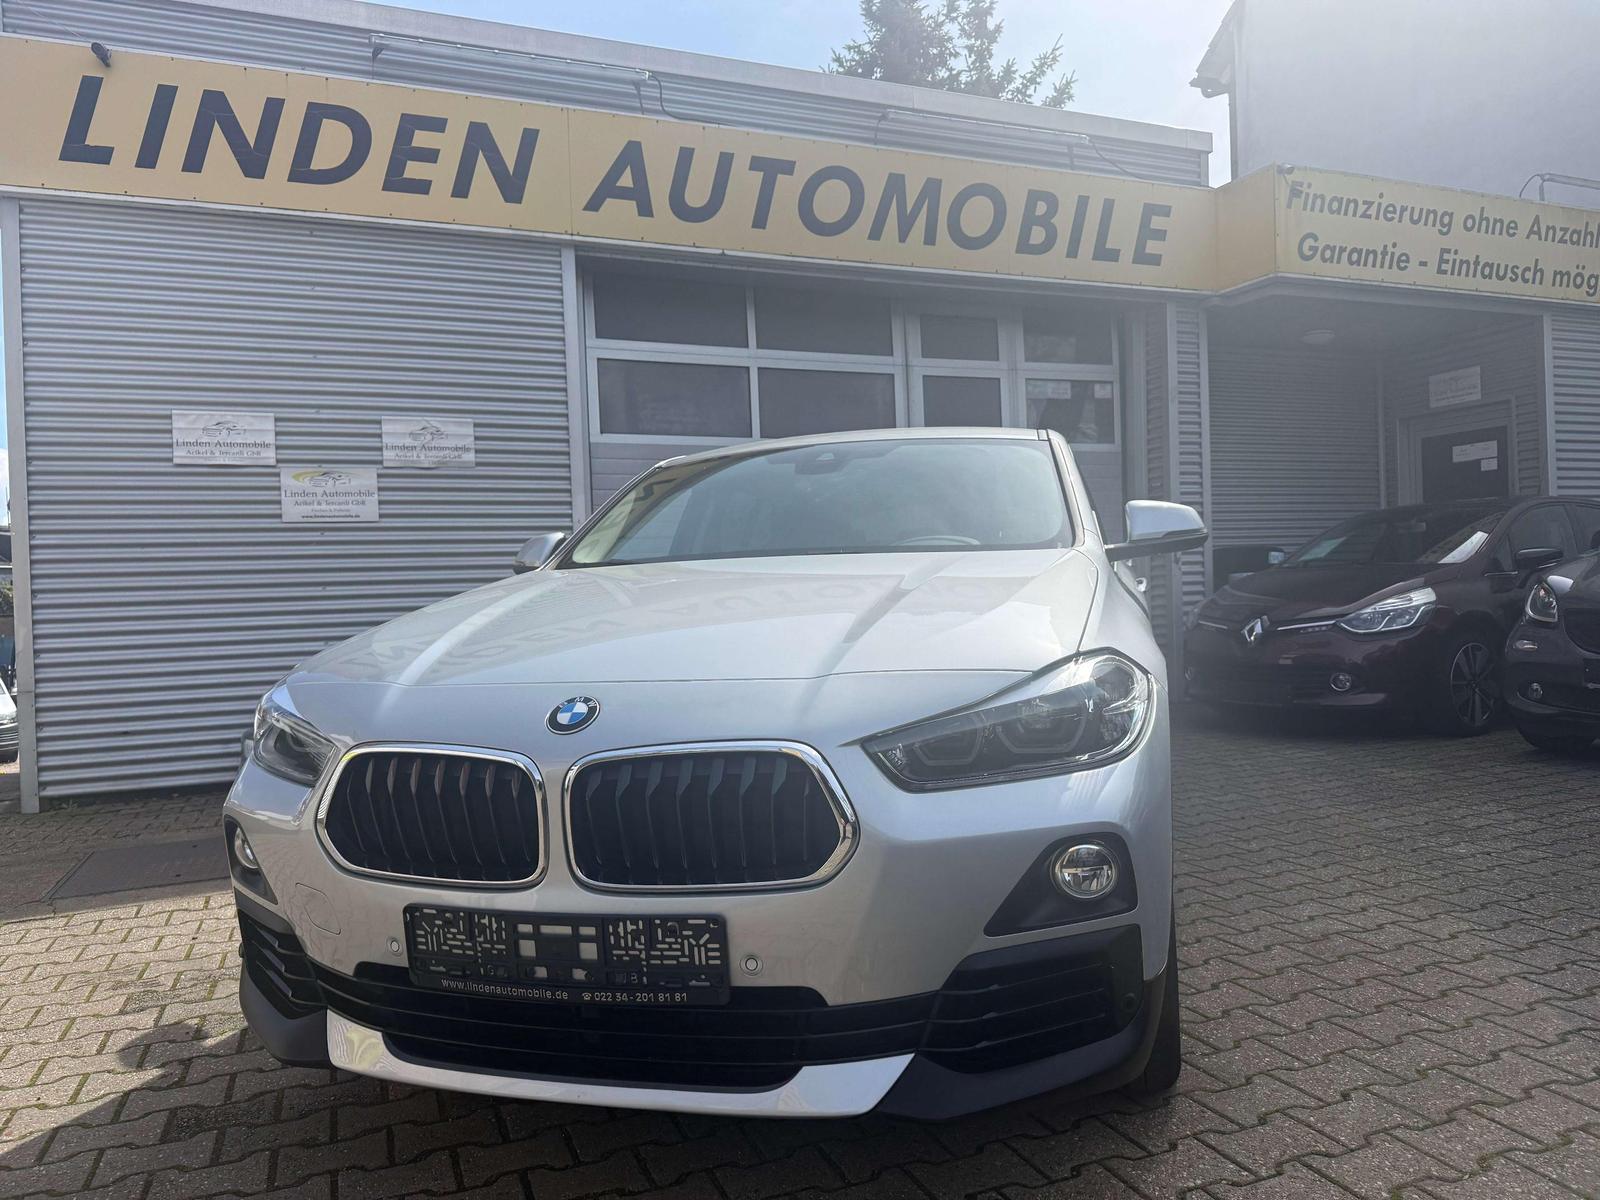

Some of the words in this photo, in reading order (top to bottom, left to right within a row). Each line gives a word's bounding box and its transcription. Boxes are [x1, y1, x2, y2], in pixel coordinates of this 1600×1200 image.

[58, 75, 540, 205] LINDEN
[582, 139, 1172, 267] AUTOMOBILE
[1286, 180, 1454, 236] Finanzierung
[1463, 207, 1518, 238] ohne
[1298, 232, 1410, 271] Garantie
[1436, 247, 1545, 286] Eintausch
[1551, 264, 1600, 298] mög
[175, 439, 211, 448] Linden
[214, 440, 272, 449] Automobile
[385, 442, 417, 452] Linden
[420, 444, 472, 453] Automobile
[284, 489, 318, 498] Linden
[321, 489, 376, 498] Automobile
[441, 979, 569, 1000] www.lindenautomobile.de
[594, 992, 613, 1001] 022
[658, 992, 671, 1003] 81
[674, 992, 688, 1003] 81
